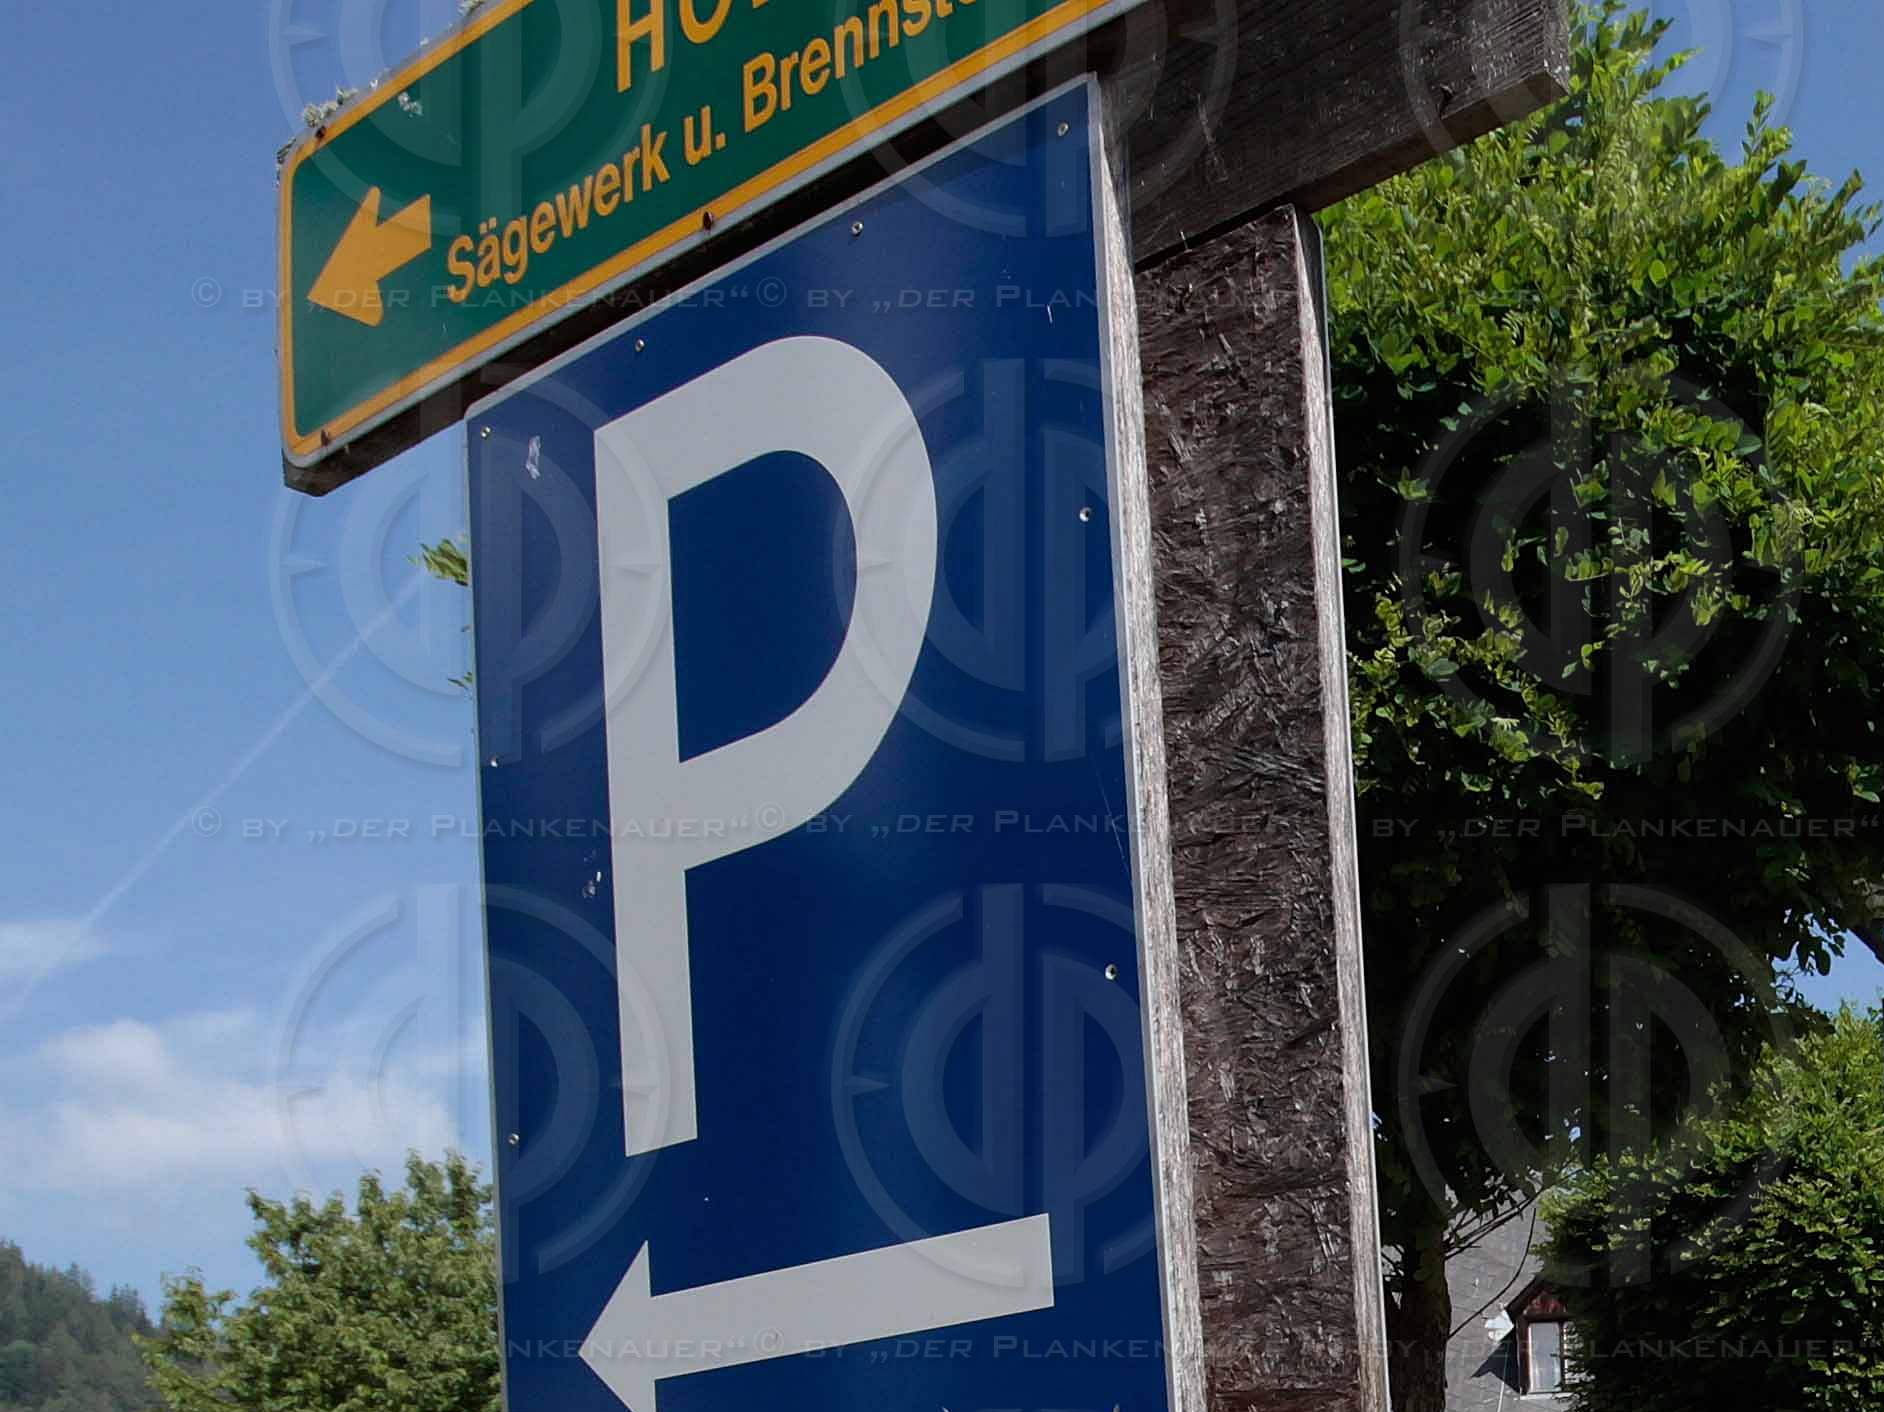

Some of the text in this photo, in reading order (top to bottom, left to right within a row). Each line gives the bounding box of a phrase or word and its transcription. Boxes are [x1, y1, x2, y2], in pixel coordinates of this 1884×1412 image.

[446, 123, 671, 303] Sägewerk
[683, 105, 727, 166] u.
[742, 0, 981, 133] Brenns
[594, 335, 938, 1157] P
